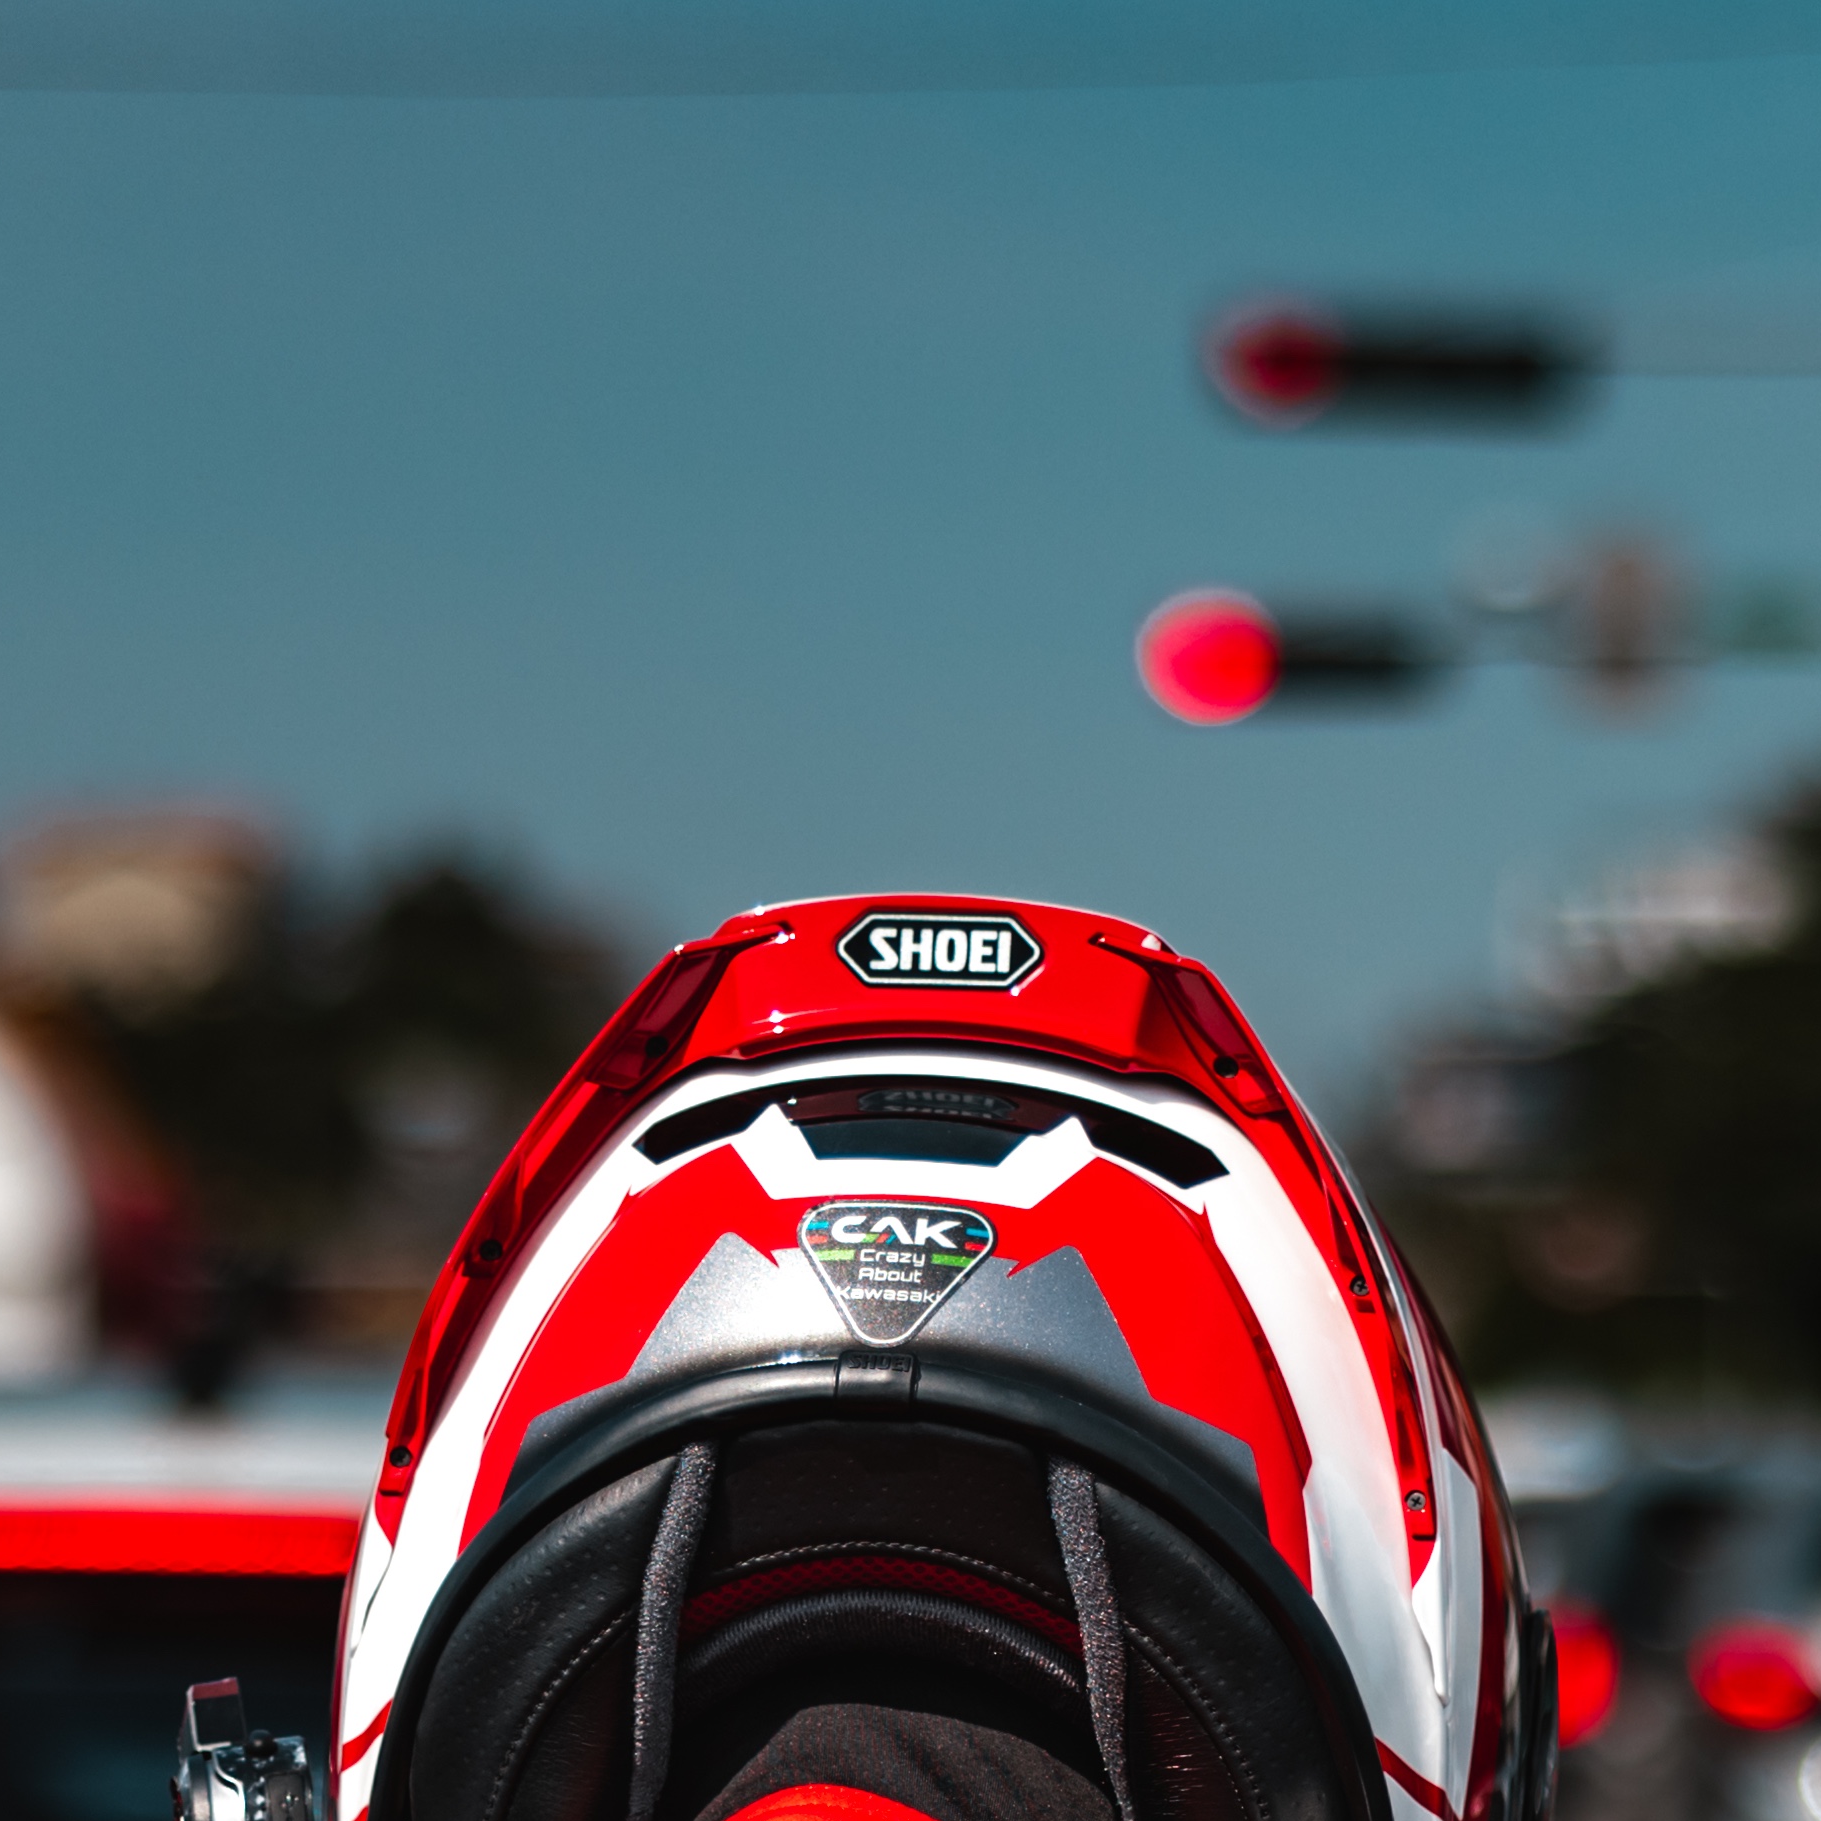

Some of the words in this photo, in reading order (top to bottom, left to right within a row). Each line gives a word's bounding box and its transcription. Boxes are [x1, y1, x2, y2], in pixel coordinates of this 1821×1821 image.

[868, 927, 1012, 973] SHOEI
[831, 1215, 962, 1249] CAK
[859, 1248, 925, 1268] Crazy
[858, 1267, 923, 1283] About
[835, 1285, 942, 1304] Kawasaki
[847, 1352, 912, 1373] SHOEI
